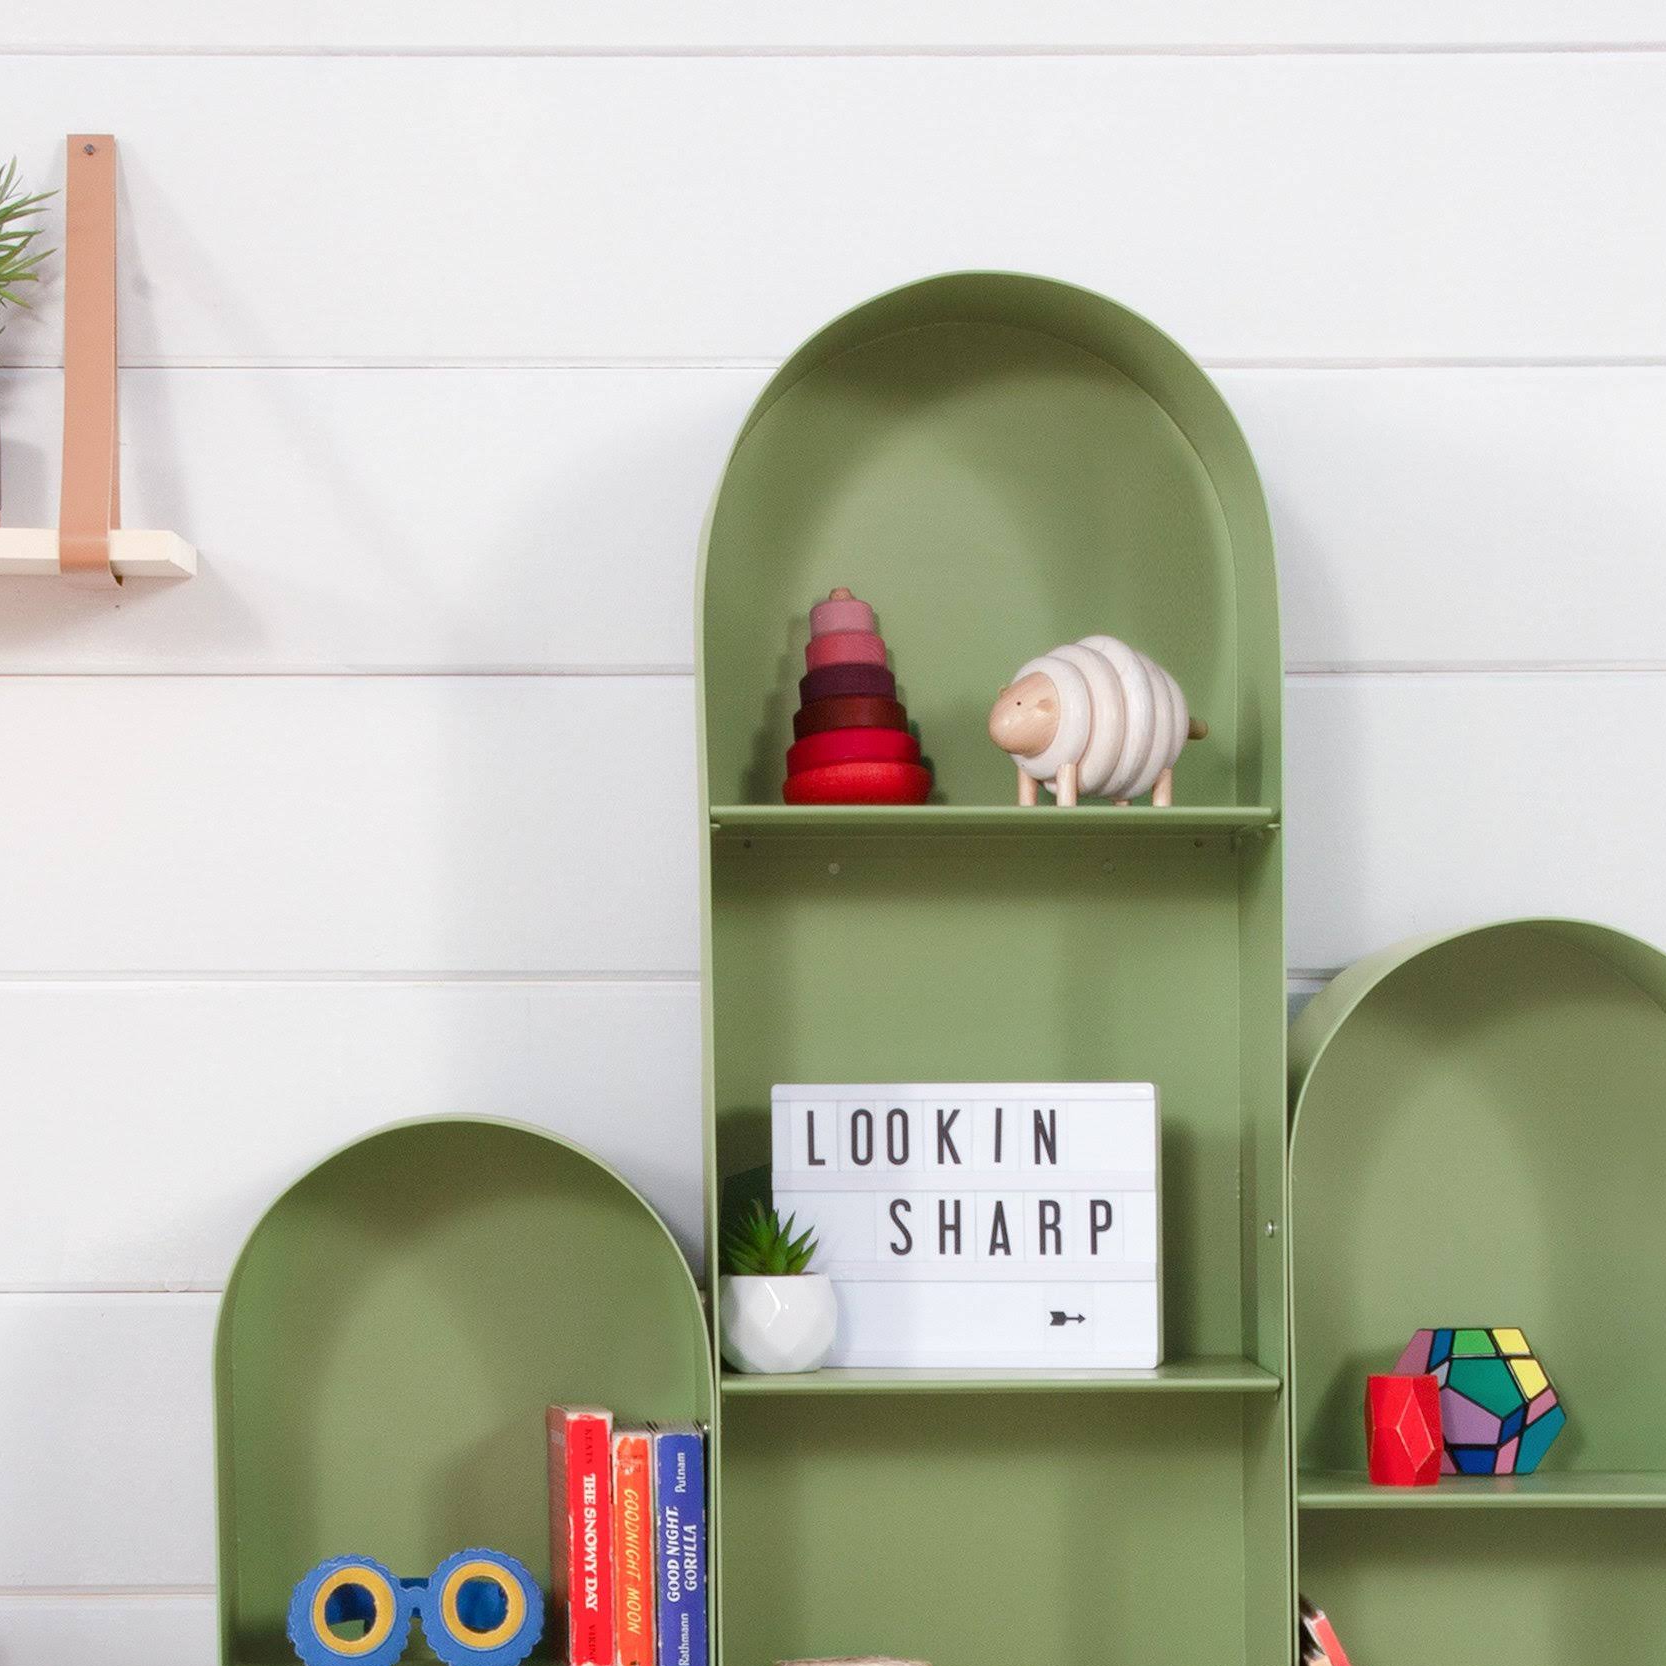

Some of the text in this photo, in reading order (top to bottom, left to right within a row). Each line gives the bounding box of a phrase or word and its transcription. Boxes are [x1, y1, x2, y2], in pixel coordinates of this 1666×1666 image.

[807, 1107, 1057, 1167] LOOKIN
[889, 1198, 1113, 1256] SHARP
[674, 1451, 686, 1493] Putnam
[583, 1473, 598, 1612] THE SNOWY DAY
[623, 1488, 642, 1581] GOODNIGHT
[682, 1523, 698, 1592] GORILLA
[666, 1559, 681, 1603] GOOD
[626, 1587, 642, 1636] MOON
[678, 1612, 690, 1666] Rathmann
